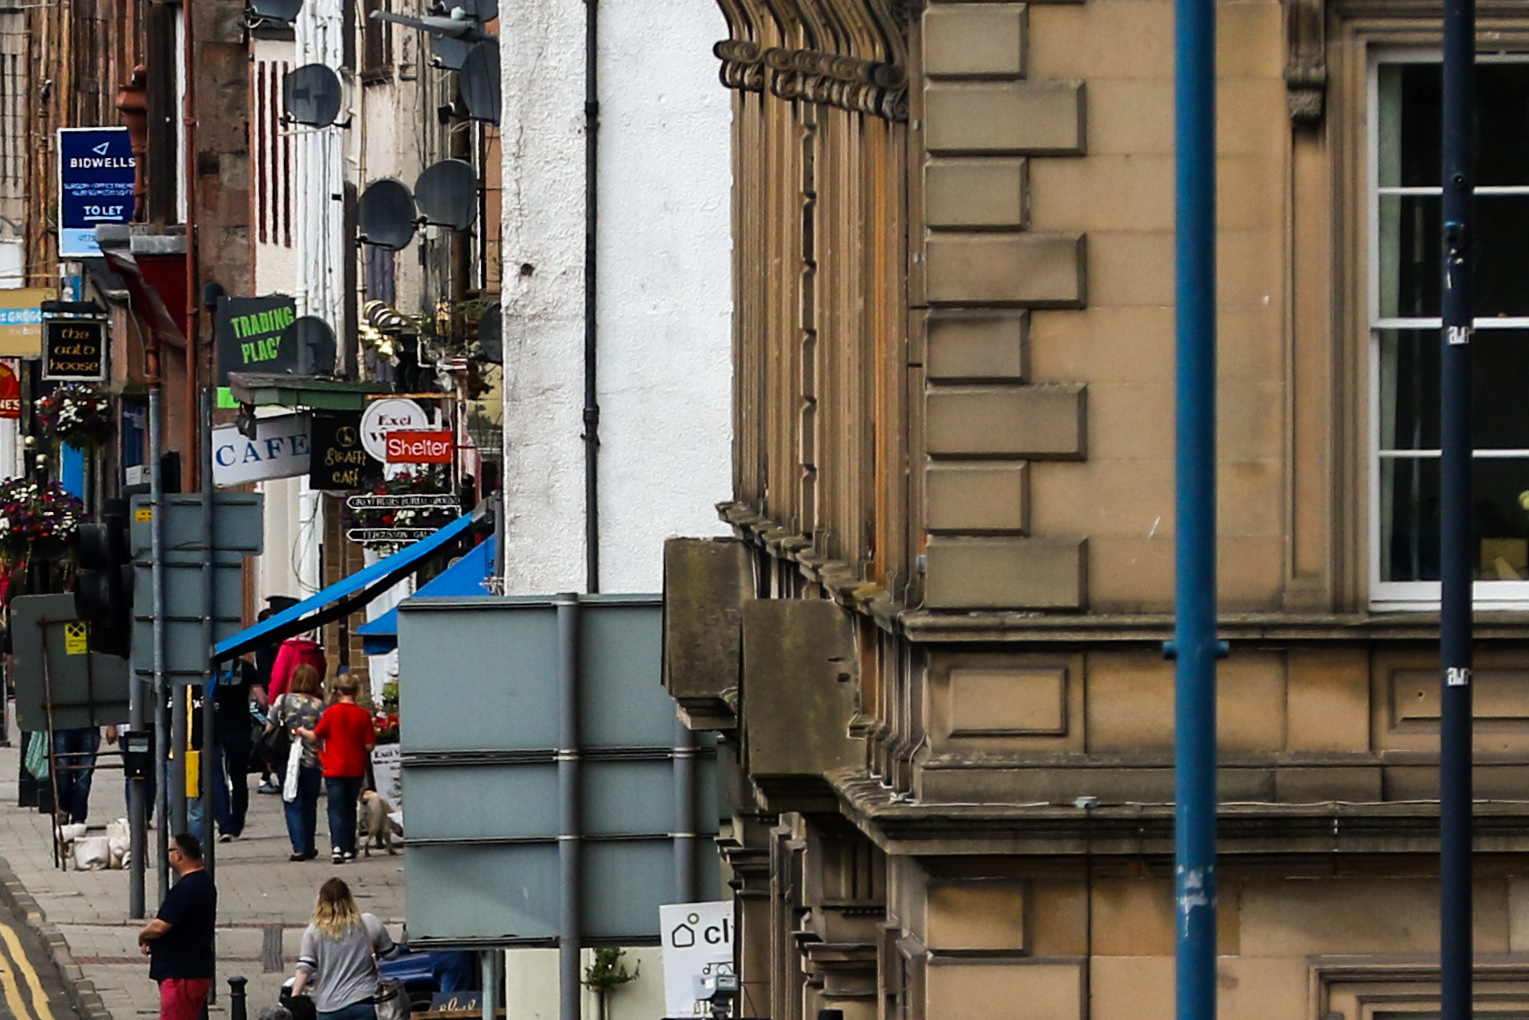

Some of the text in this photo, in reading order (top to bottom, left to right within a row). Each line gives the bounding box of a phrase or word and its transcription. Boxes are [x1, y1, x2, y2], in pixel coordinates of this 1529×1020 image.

[69, 157, 137, 169] BIDWELLS
[83, 205, 124, 216] TO LET
[230, 306, 294, 339] TRADING
[377, 412, 412, 426] Exel
[215, 433, 311, 468] CAFE
[387, 437, 450, 457] Shelter
